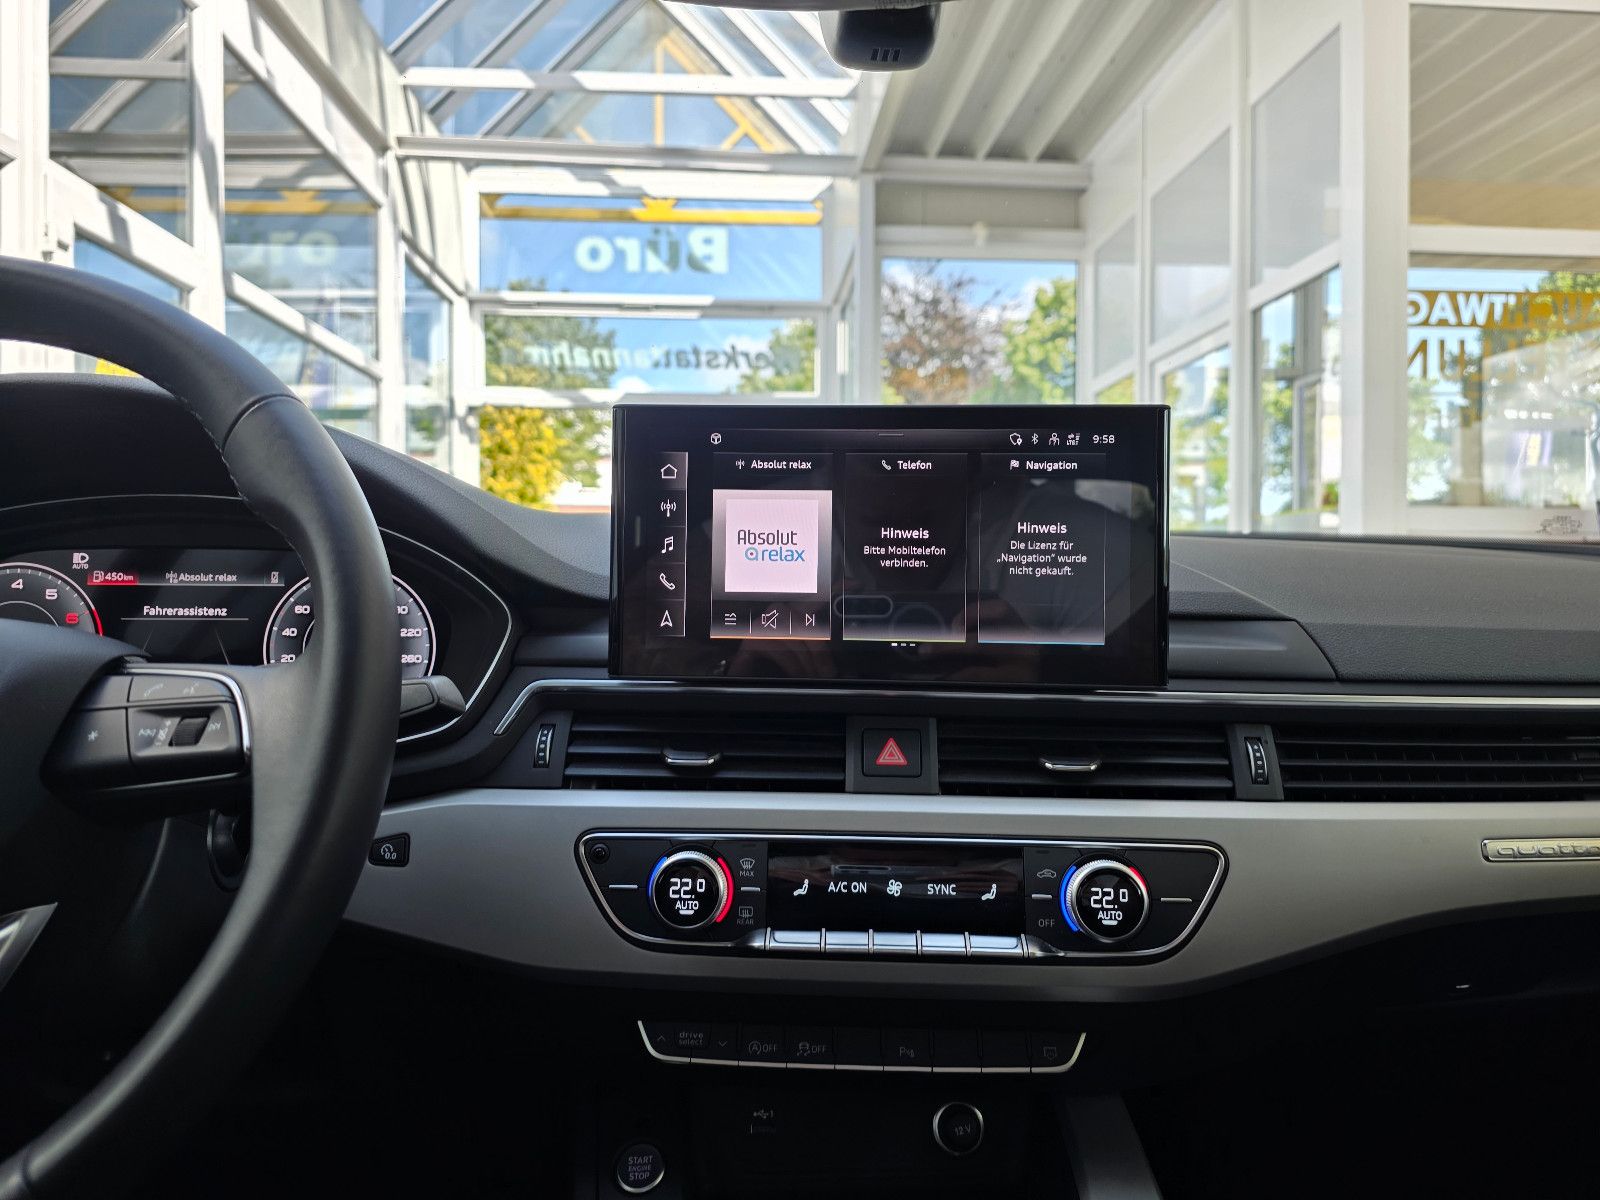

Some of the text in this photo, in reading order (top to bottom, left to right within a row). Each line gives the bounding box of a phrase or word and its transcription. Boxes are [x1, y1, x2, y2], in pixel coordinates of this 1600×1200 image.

[1092, 434, 1115, 444] 9:58
[750, 459, 812, 469] Absolut relax
[897, 460, 932, 470] Telefon
[1025, 460, 1078, 471] Navigation
[1017, 521, 1067, 534] Hinweis
[737, 529, 798, 546] Absolut
[881, 527, 930, 539] Hinweis
[863, 545, 946, 555] Bitte Mobiltelefon
[1010, 540, 1074, 550] Die Lizenz für
[880, 558, 929, 567] verbinden.
[1057, 553, 1088, 563] wurde
[1009, 565, 1074, 577] nicht gekauft.
[178, 572, 237, 582] Absolut relax
[11, 578, 24, 590] 4
[45, 588, 58, 600] 5
[143, 605, 228, 617] Fahrerassistenz
[294, 605, 310, 615] 60
[65, 612, 79, 625] 6
[281, 627, 298, 637] 40
[400, 627, 422, 637] 220
[280, 654, 296, 663] 20
[827, 881, 867, 894] A/C ON
[927, 883, 957, 896] SYNC
[675, 900, 699, 910] AUTO
[1097, 910, 1123, 920] AUTO
[1038, 918, 1055, 928] OFF
[679, 1031, 704, 1039] drive
[762, 1043, 777, 1053] OFF
[811, 1044, 826, 1054] OFF
[628, 1155, 653, 1165] START
[629, 1171, 650, 1181] STOP
